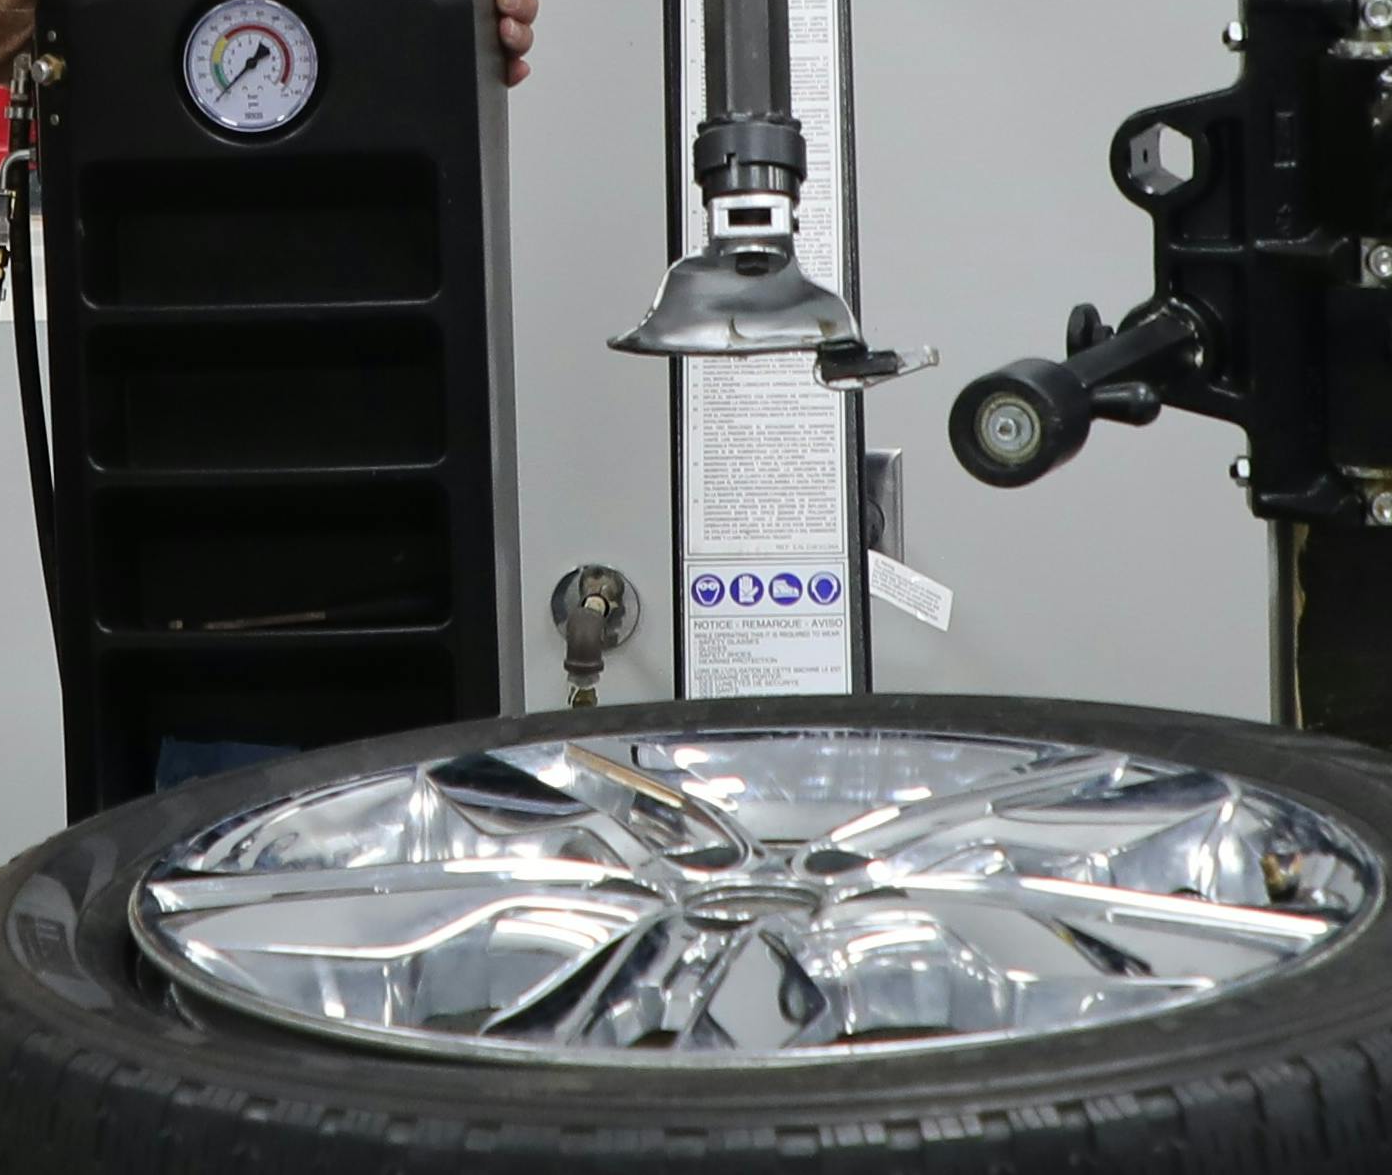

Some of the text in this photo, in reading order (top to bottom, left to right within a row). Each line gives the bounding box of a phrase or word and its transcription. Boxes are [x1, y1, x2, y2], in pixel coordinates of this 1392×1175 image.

[694, 618, 843, 629] NOTICE REMARQUE AVISO
